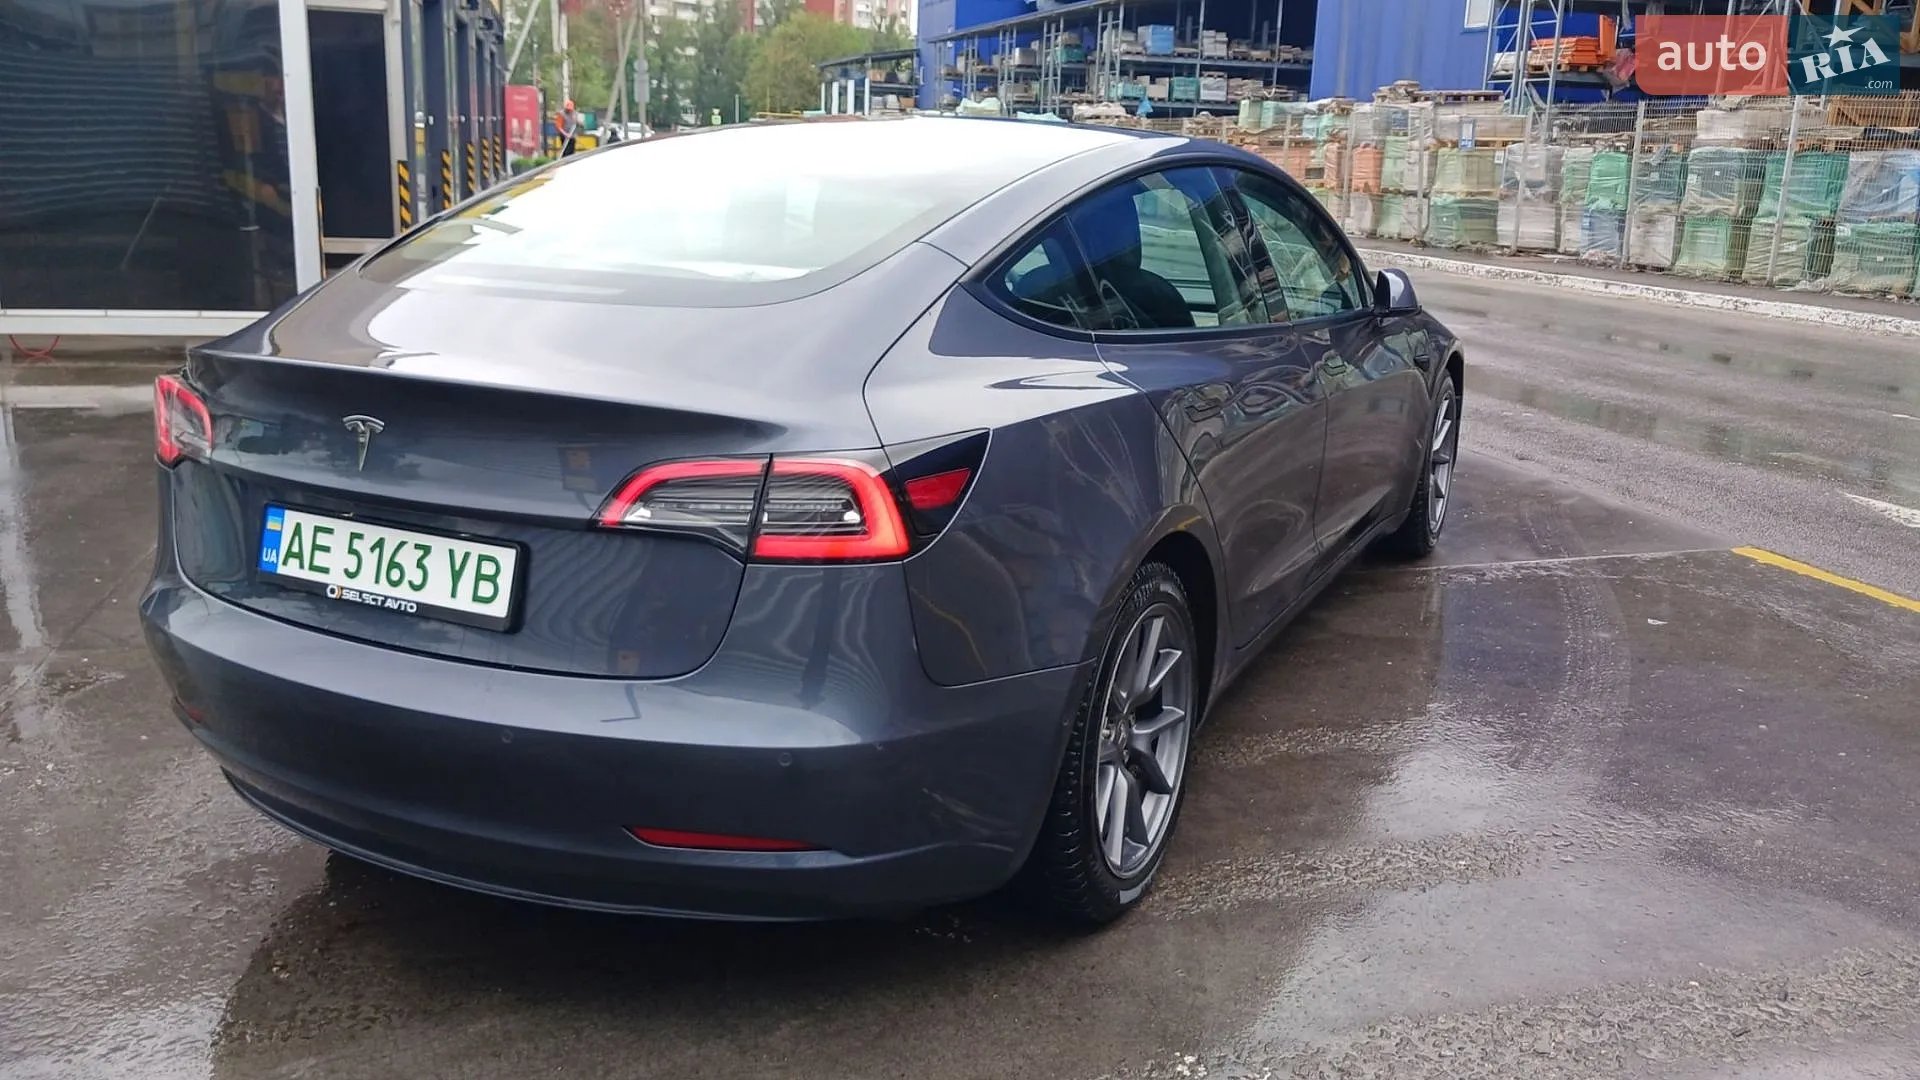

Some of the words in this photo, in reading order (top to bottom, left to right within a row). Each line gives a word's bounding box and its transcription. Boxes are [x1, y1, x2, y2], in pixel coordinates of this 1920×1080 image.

[263, 547, 277, 564] UA
[282, 521, 335, 575] AE
[343, 531, 432, 593] 5163
[448, 548, 502, 605] YB
[384, 598, 417, 613] AVTO
